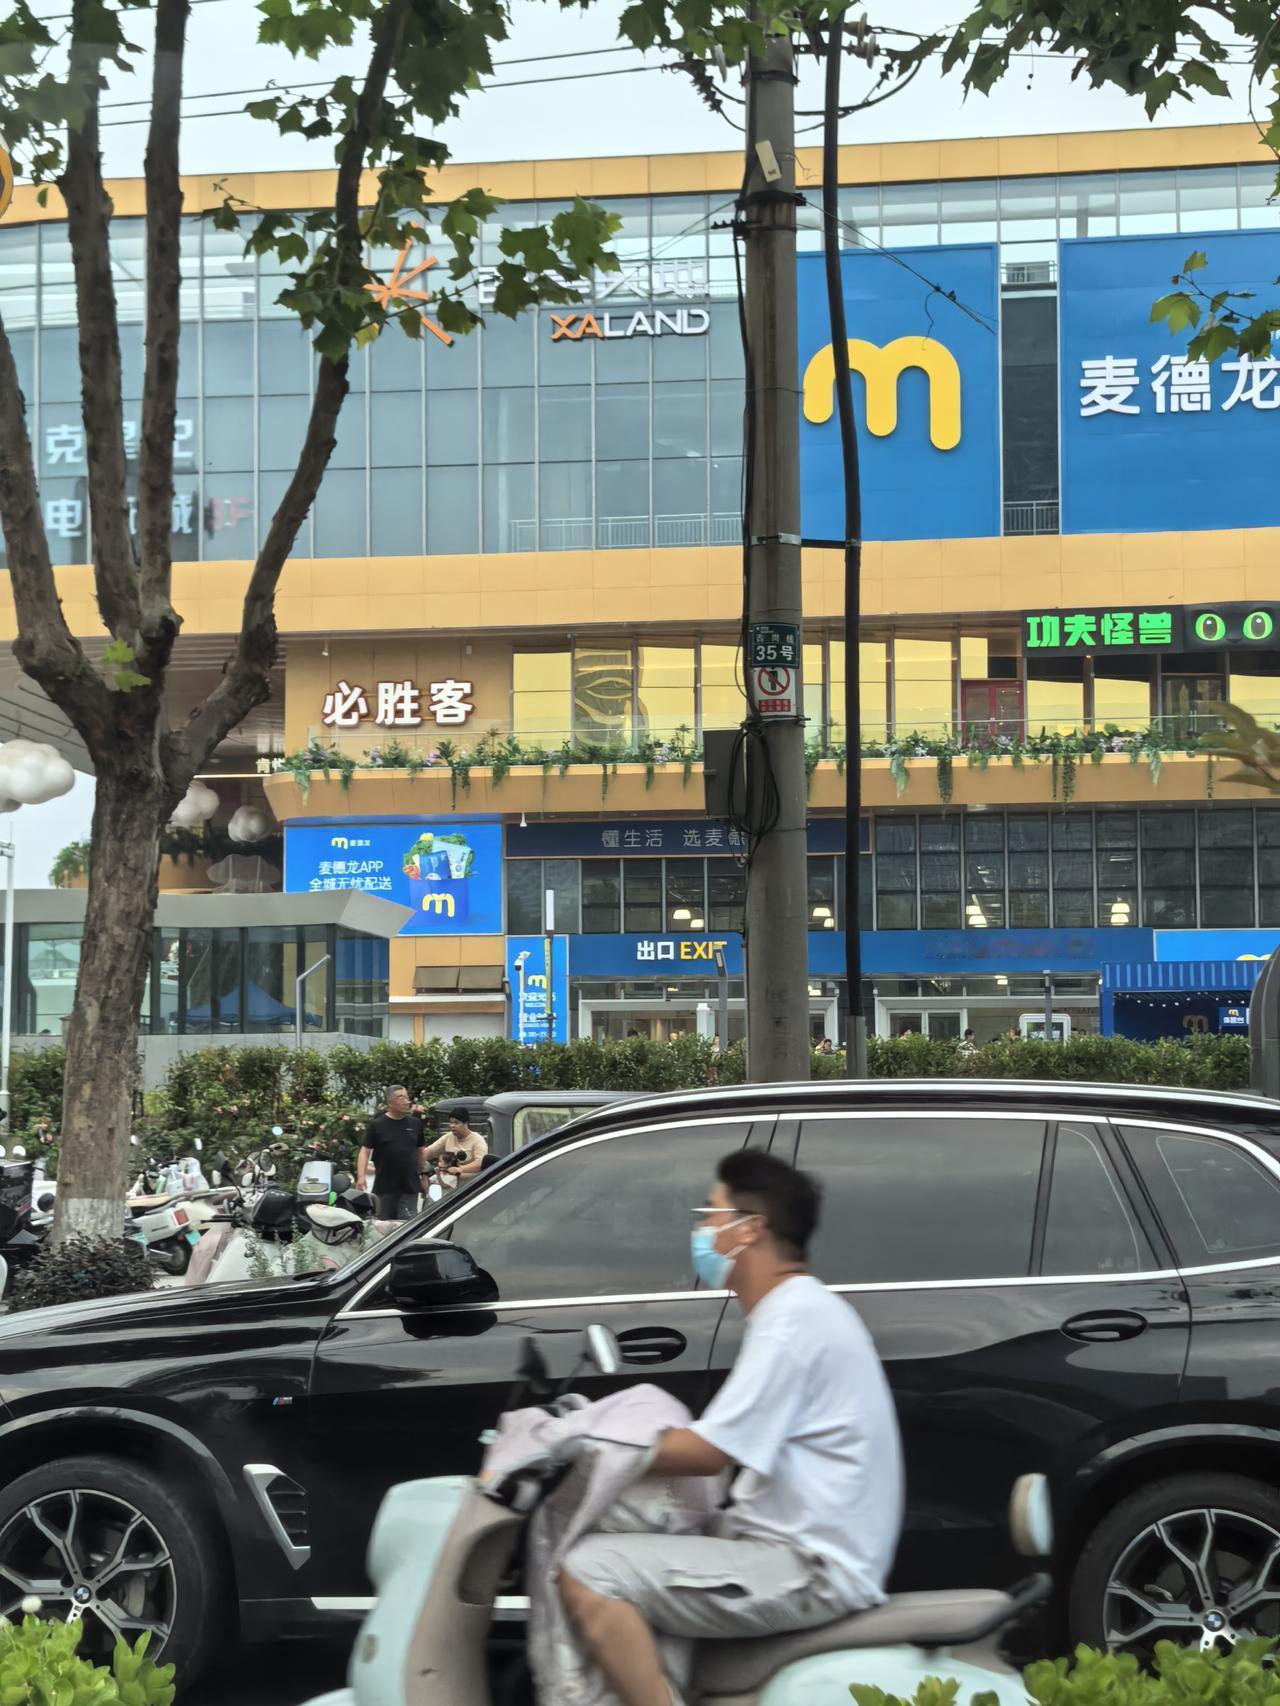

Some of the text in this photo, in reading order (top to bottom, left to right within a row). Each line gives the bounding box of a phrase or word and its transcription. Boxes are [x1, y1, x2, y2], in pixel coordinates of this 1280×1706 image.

[550, 309, 710, 340] XALAND
[1080, 352, 1280, 417] 麦德龙
[1026, 612, 1172, 648] 功夫怪兽
[322, 679, 473, 727] 必胜客
[318, 860, 384, 875] 麦德龙APP
[637, 940, 675, 960] 出口
